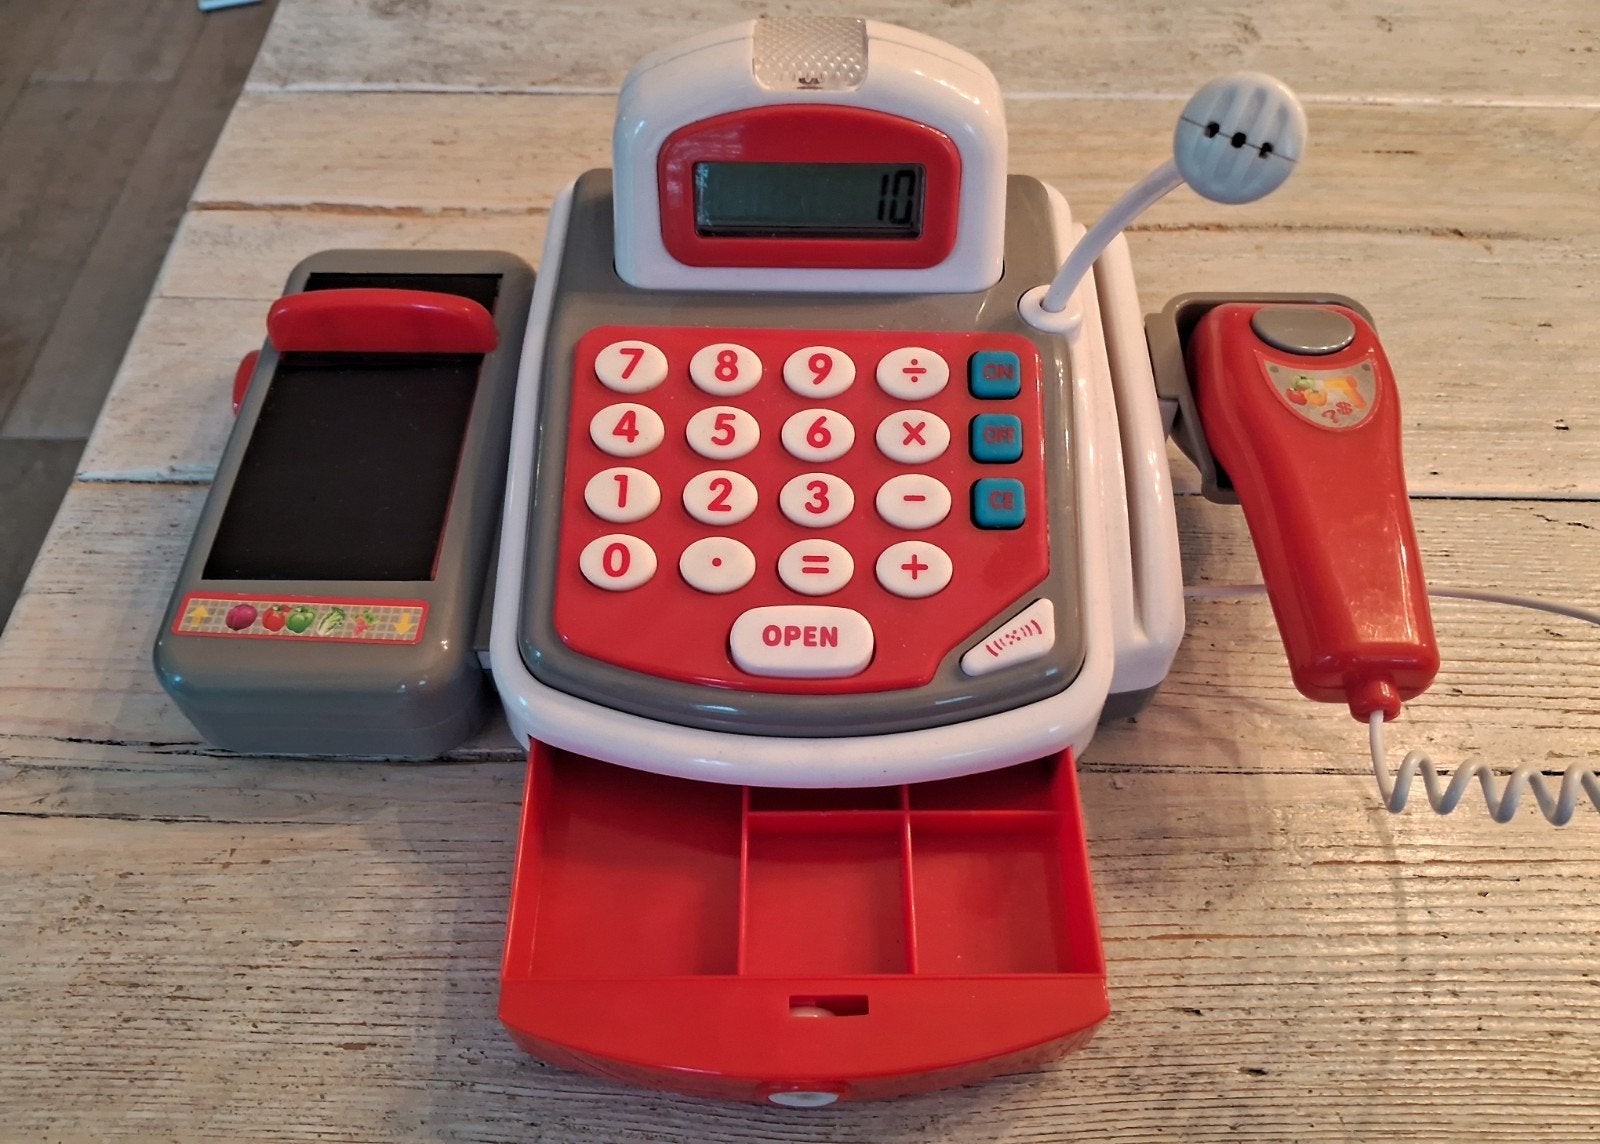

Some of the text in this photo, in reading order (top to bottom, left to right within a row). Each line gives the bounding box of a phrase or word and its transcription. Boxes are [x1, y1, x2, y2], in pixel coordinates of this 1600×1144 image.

[619, 347, 645, 380] 7
[714, 349, 740, 383] 8
[807, 352, 834, 386] 9
[983, 362, 1014, 381] ON
[612, 409, 640, 444] 4
[710, 412, 737, 447] 5
[805, 415, 832, 449] 6
[983, 425, 1016, 445] OFF
[613, 474, 629, 509] 1
[707, 477, 733, 513] 2
[804, 479, 830, 515] 3
[989, 490, 1015, 510] CE
[602, 542, 631, 578] 0
[762, 624, 838, 648] OPEN
